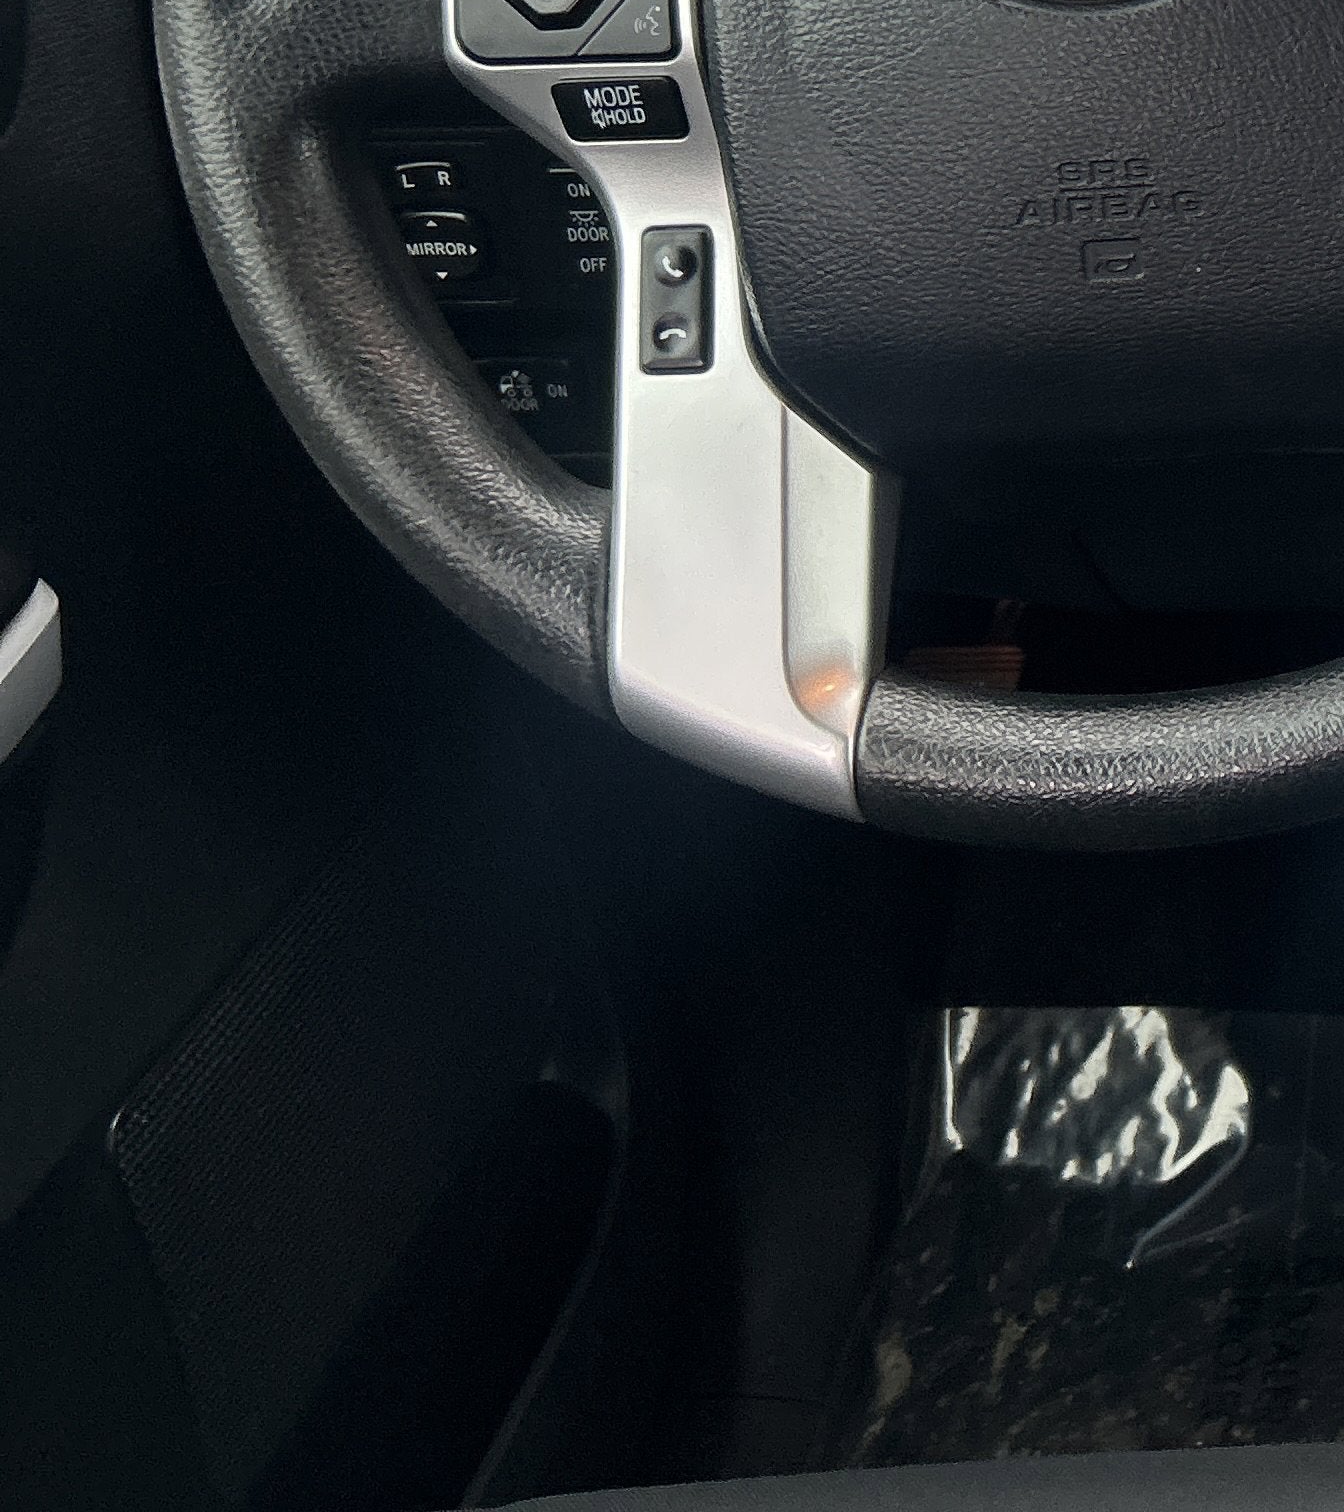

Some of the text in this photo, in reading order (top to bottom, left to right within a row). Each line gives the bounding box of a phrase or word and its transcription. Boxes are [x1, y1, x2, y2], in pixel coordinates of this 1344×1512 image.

[583, 84, 644, 109] MODE
[604, 107, 647, 126] HOLD
[401, 171, 452, 189] L R
[567, 183, 591, 197] ON
[567, 226, 610, 242] DOOR
[406, 241, 468, 257] MIRROR
[579, 257, 608, 273] OFF
